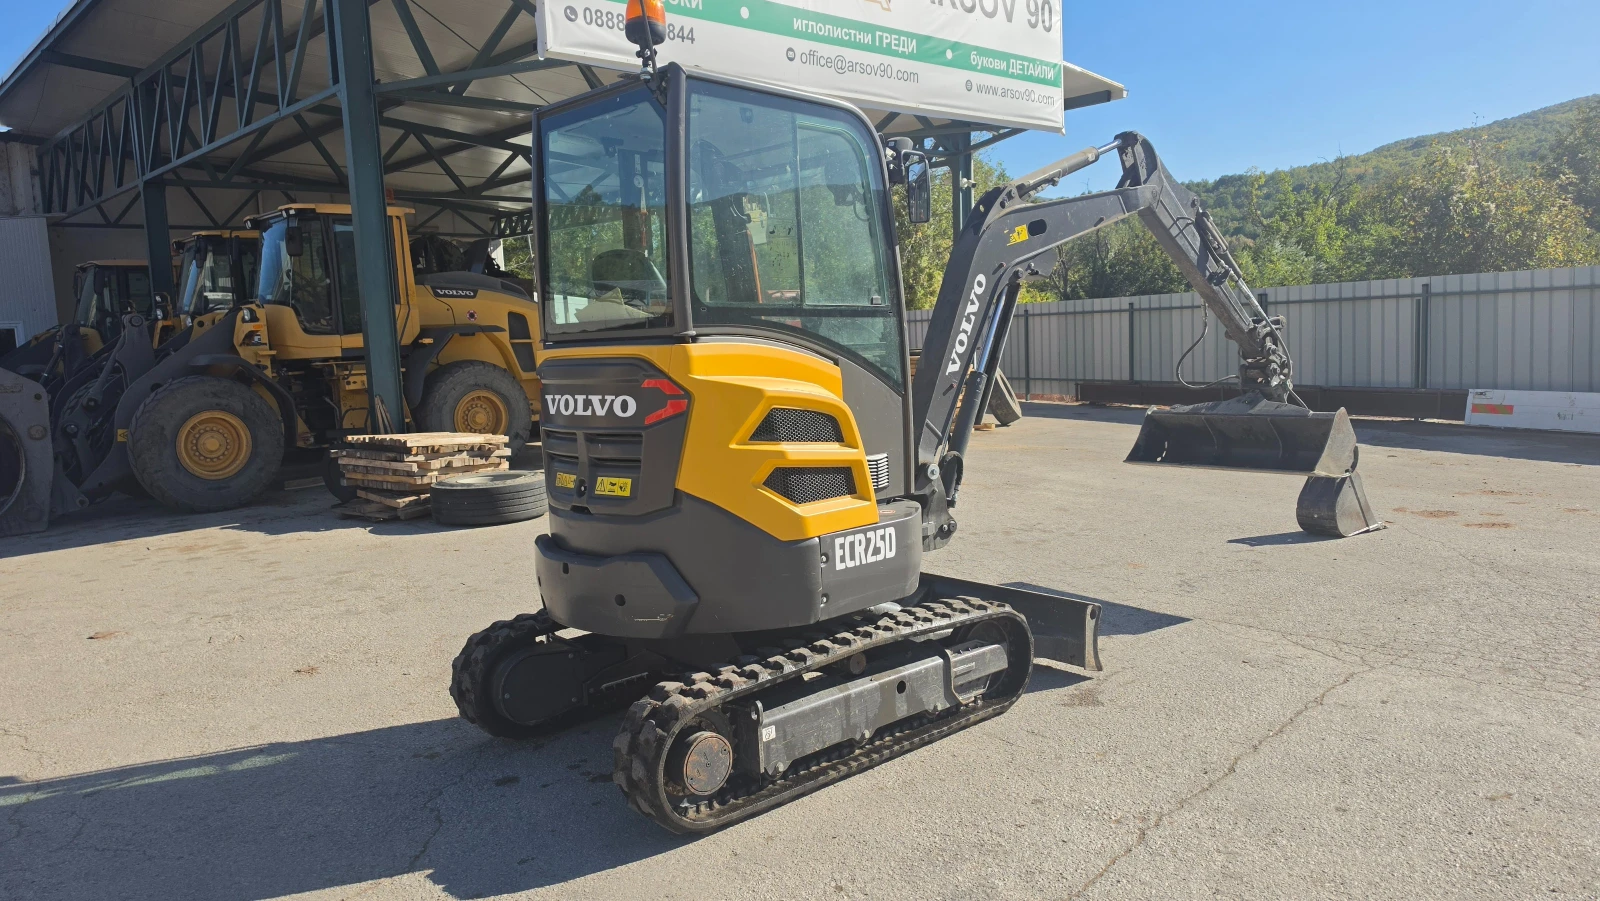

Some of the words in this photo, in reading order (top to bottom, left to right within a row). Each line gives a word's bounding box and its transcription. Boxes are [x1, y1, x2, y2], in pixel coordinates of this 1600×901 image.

[583, 7, 625, 31] 0888
[667, 23, 696, 44] 844
[1026, 0, 1053, 33] 90
[793, 18, 872, 44] иглолистни
[875, 31, 917, 54] ГРЕДИ
[800, 49, 919, 83] office@arsov90.com
[970, 51, 1007, 71] букови
[1009, 58, 1054, 80] ДЕТАЙЛИ
[976, 83, 1055, 106] www.arsov90.com
[946, 273, 987, 375] VOLVO
[545, 394, 637, 417] VOLVO
[834, 526, 897, 570] ECR25D
